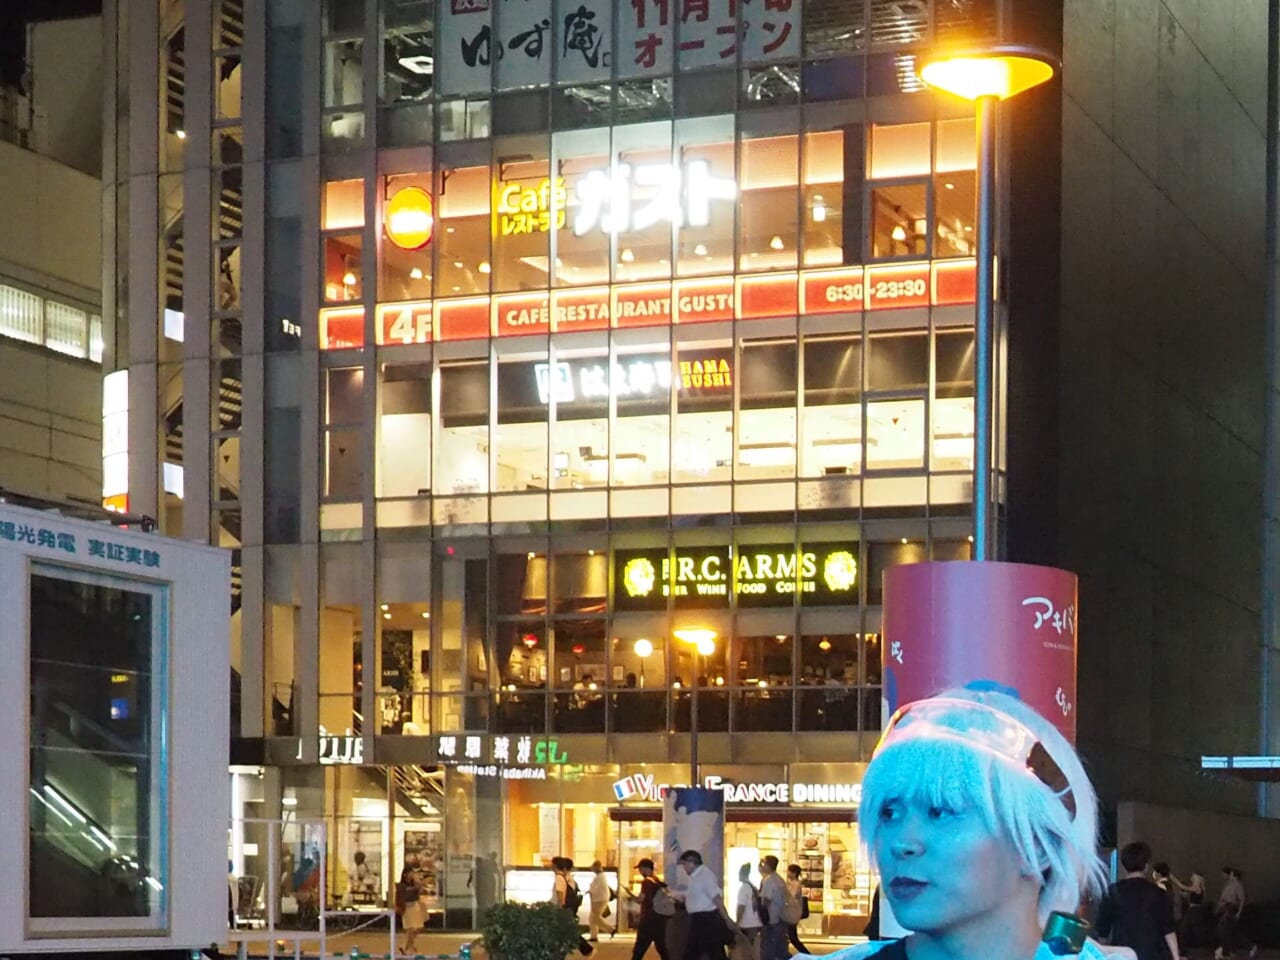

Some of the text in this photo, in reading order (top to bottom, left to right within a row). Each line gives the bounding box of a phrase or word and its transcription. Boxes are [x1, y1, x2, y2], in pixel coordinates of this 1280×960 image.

[634, 22, 792, 68] オープン
[501, 177, 567, 213] Café
[389, 308, 431, 345] 4F
[506, 301, 549, 326] CAFÉ
[679, 359, 730, 375] HAMA
[736, 553, 816, 579] ARMS
[696, 583, 727, 595] WINE
